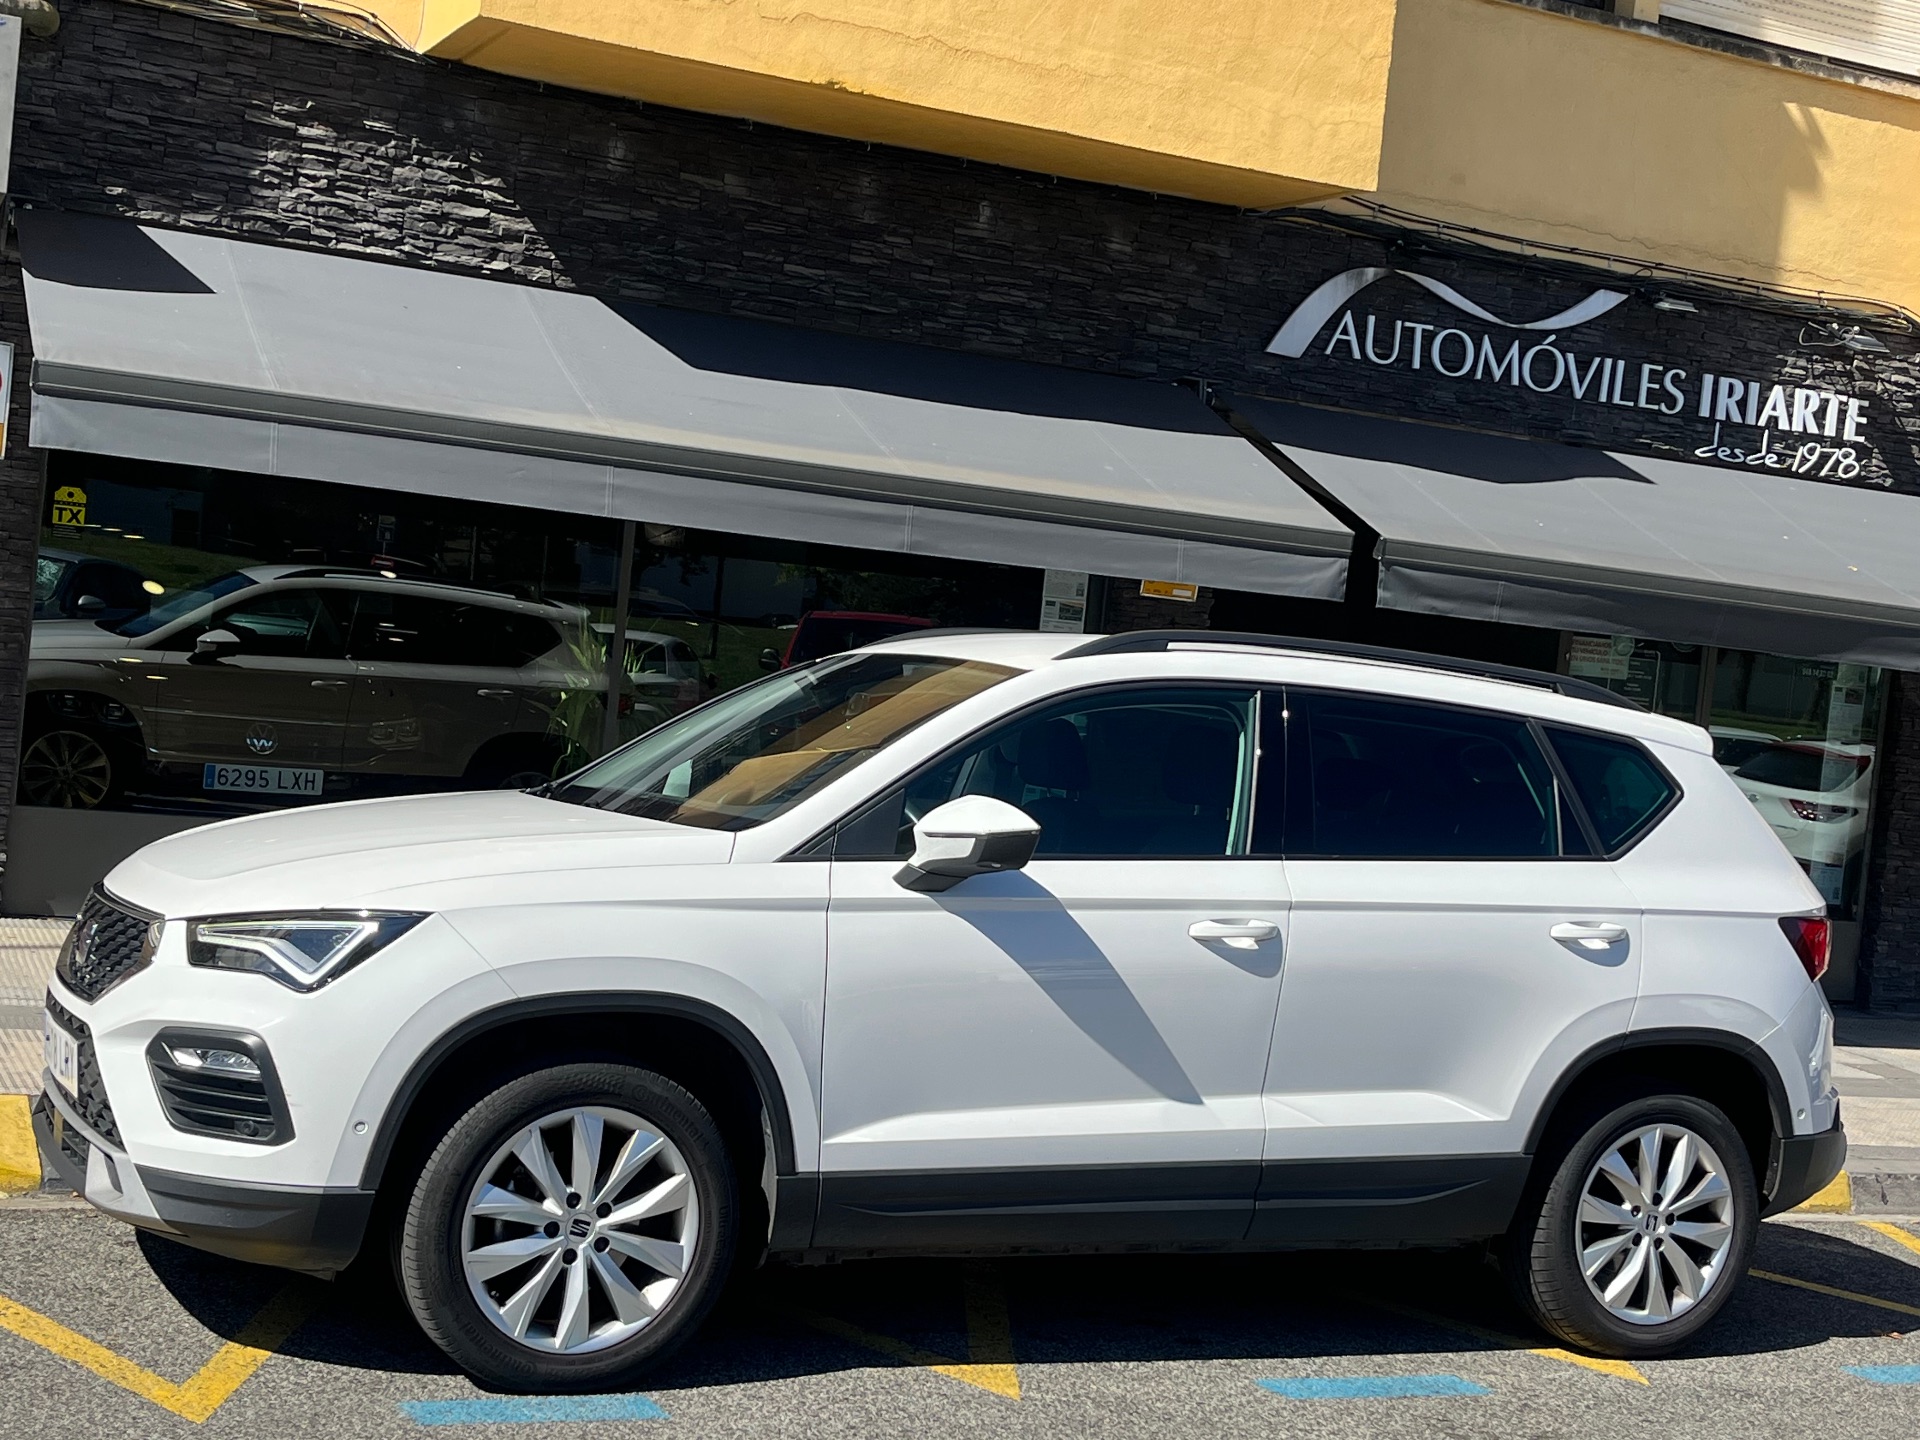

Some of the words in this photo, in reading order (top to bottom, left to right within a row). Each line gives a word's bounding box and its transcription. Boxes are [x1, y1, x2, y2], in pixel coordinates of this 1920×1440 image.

[1324, 309, 1687, 414] AUTOMÓVILES
[1698, 373, 1870, 443] IRIARTE
[1694, 421, 1787, 468] desde
[1792, 442, 1860, 478] 1978
[55, 507, 83, 524] TX
[217, 768, 269, 788] 6295
[278, 770, 316, 791] LXH
